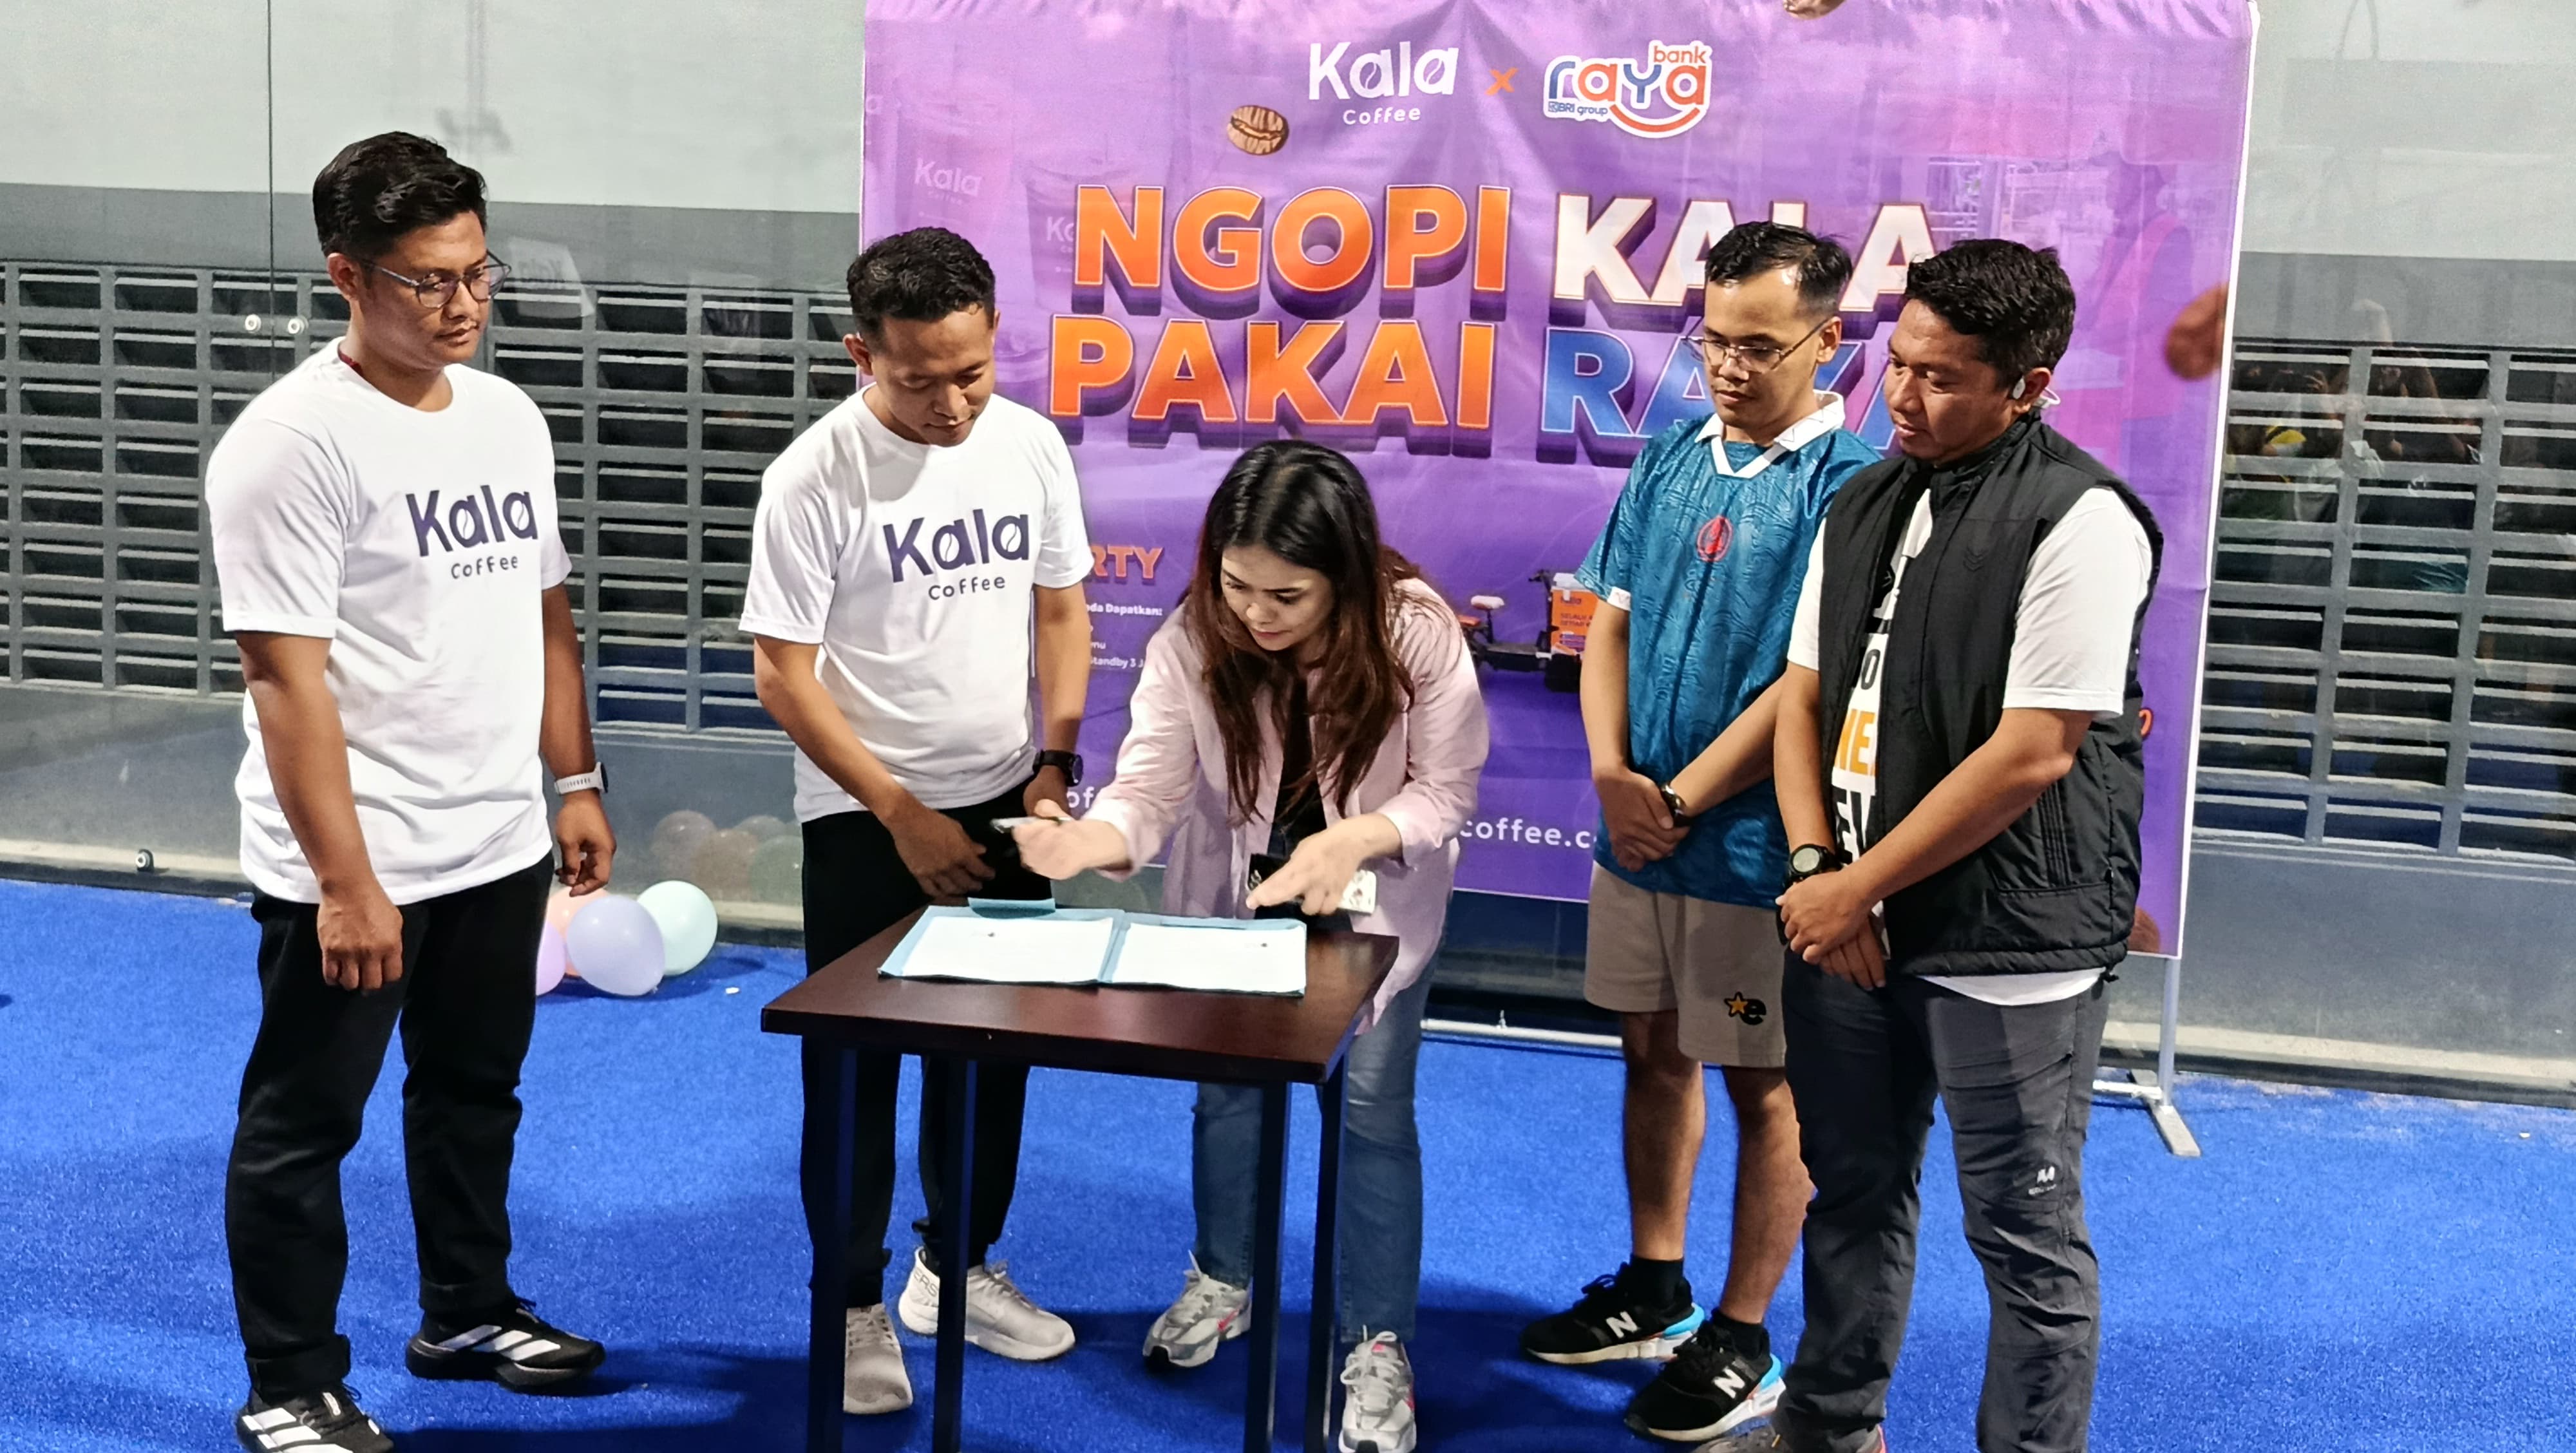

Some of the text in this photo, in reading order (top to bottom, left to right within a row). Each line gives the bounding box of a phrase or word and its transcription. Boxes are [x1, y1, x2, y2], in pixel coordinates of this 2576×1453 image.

[1309, 41, 1459, 100] Kala
[1653, 45, 1707, 64] bank
[1548, 61, 1707, 106] raya
[1343, 106, 1421, 125] Coffee
[1558, 102, 1608, 117] BRI group
[1074, 184, 1936, 312] NGOPI KAA
[1050, 314, 1897, 450] PAKAI RA
[405, 484, 538, 558] Kala
[882, 508, 1030, 583] Kala
[451, 555, 518, 580] Coffee
[928, 576, 1006, 600] Coffee
[1105, 603, 1163, 616] Dapatkan:
[1459, 817, 1597, 849] coffee.c
